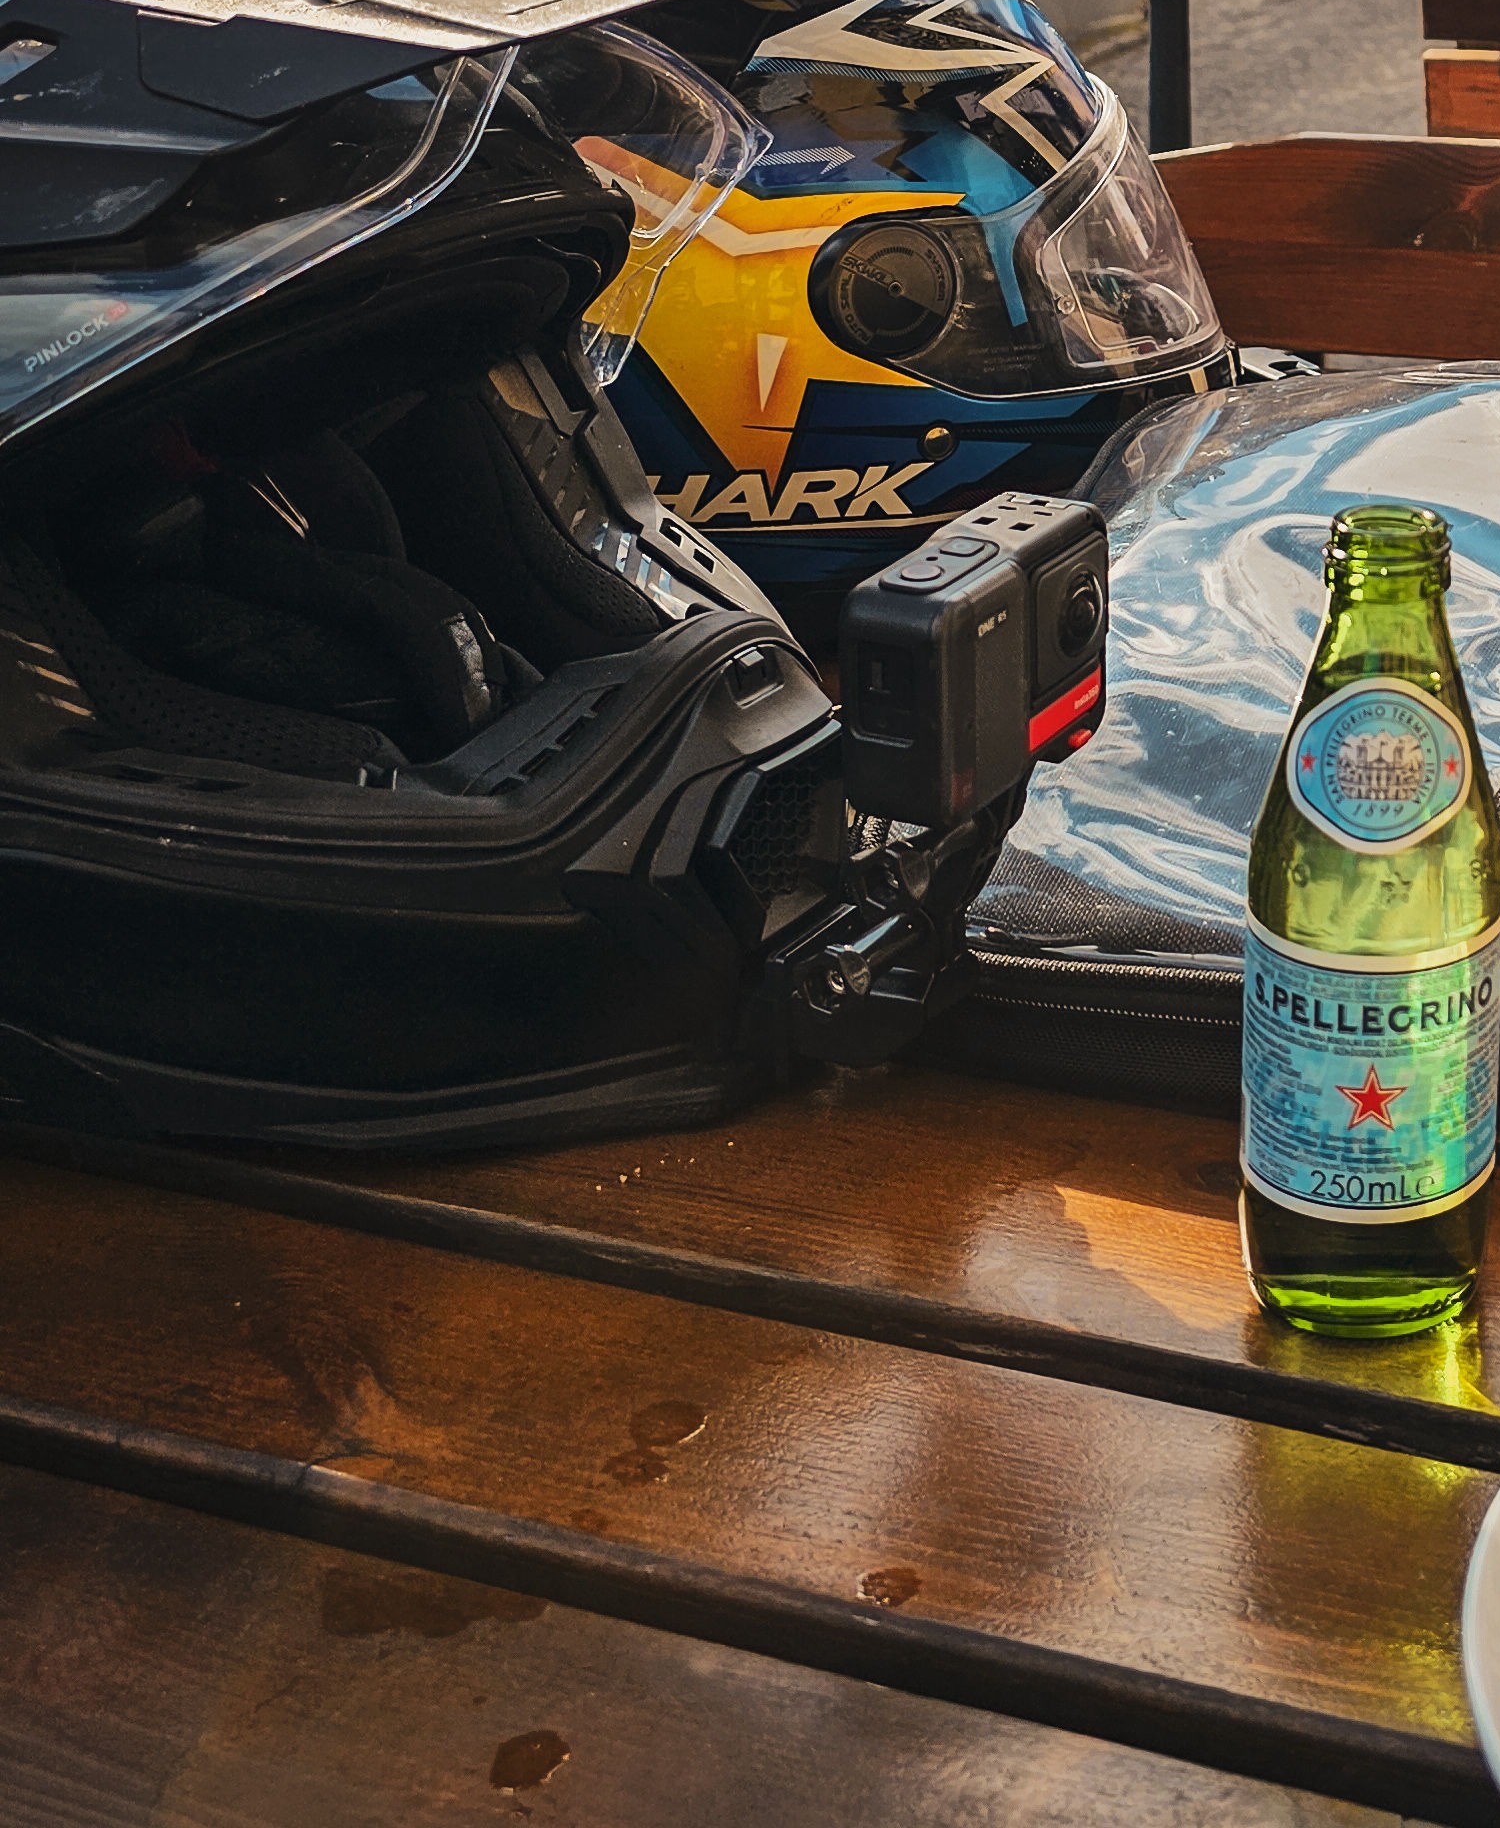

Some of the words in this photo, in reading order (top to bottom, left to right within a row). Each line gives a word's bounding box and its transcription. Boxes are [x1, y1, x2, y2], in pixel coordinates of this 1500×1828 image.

[25, 314, 109, 372] PINLOCK
[645, 461, 936, 522] HARK
[1392, 707, 1430, 741] TERME
[1353, 803, 1404, 818] 1899
